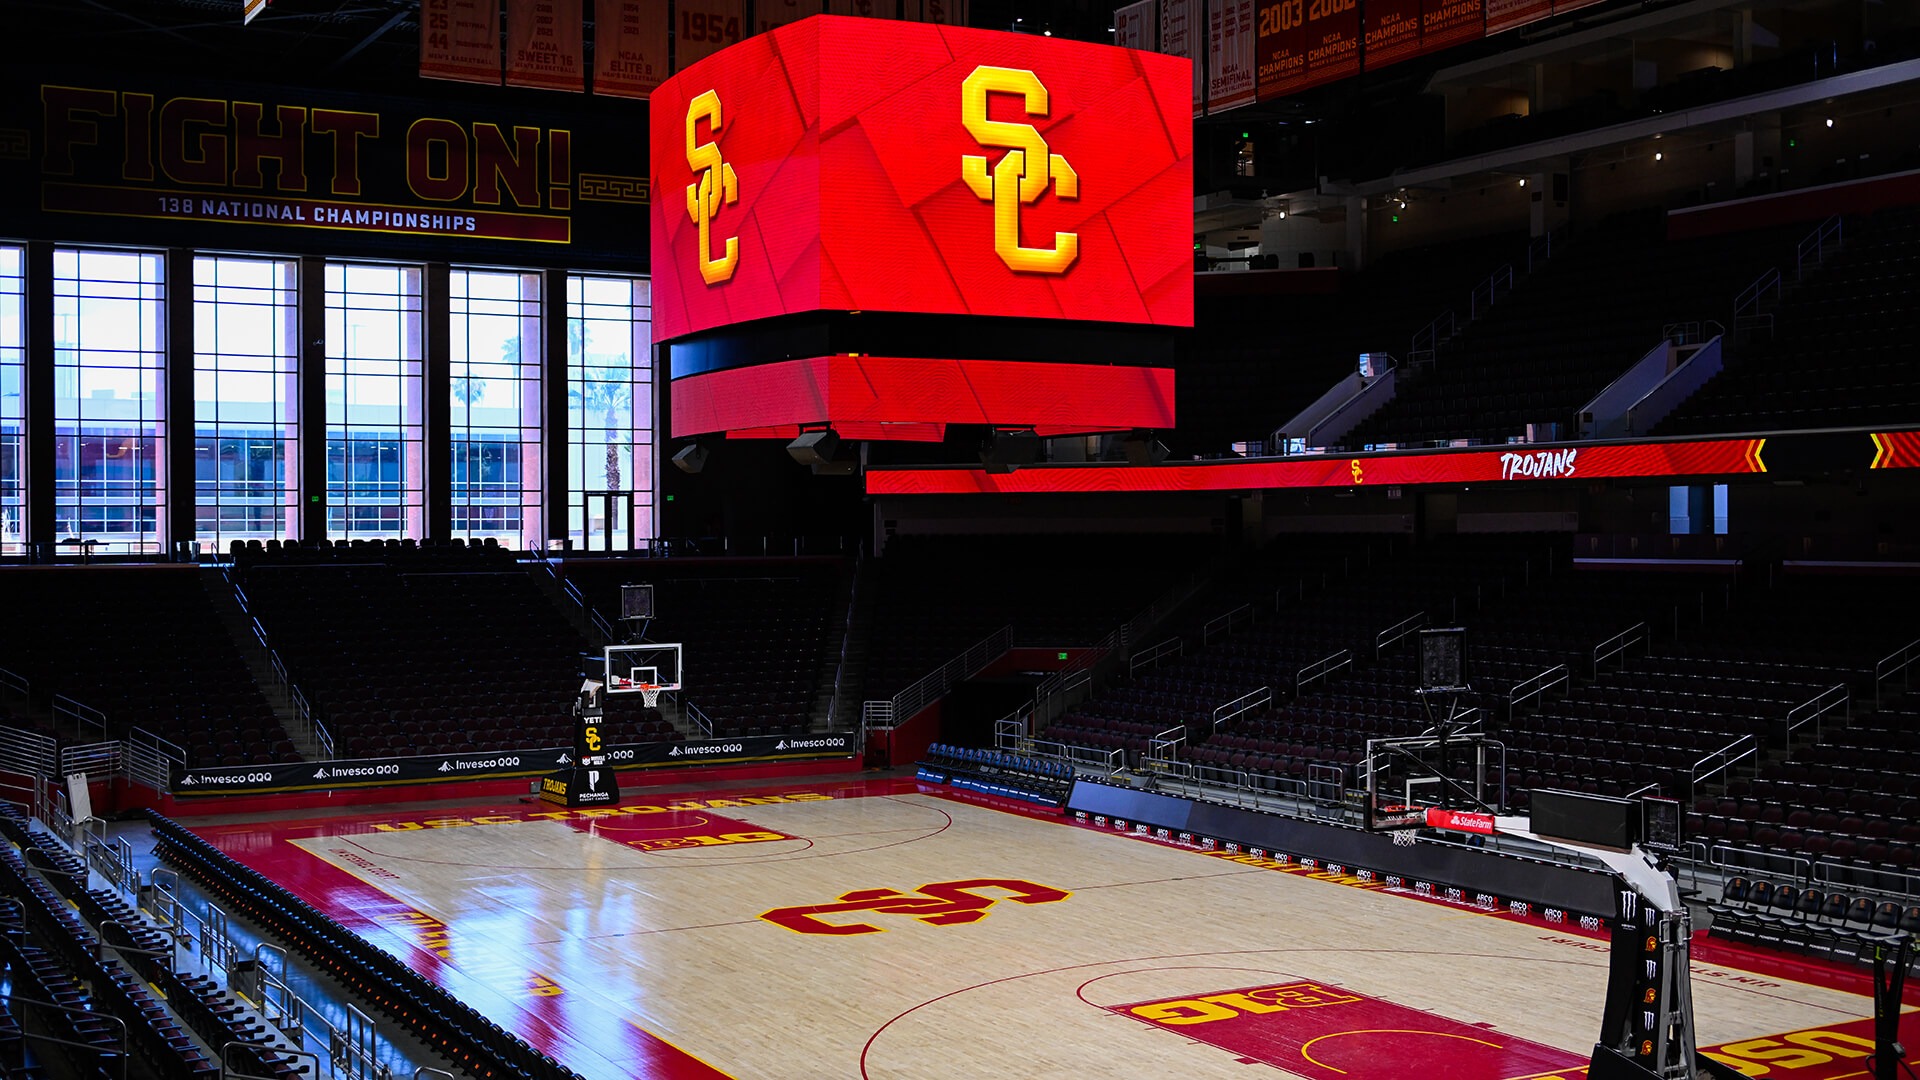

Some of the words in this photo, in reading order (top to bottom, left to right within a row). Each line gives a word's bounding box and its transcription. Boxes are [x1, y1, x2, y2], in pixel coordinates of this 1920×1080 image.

[1259, 0, 1303, 38] 2003
[1380, 12, 1400, 26] NCAA
[1424, 0, 1481, 26] CHAMPIONS
[1448, 12, 1480, 26] VOLLEYBALL
[430, 13, 448, 29] 25
[682, 11, 740, 43] 1954
[1119, 15, 1126, 30] 10
[537, 27, 553, 36] 2021
[1365, 17, 1418, 44] CHAMPIONS
[429, 32, 448, 49] 44
[1323, 32, 1341, 45] NCAA
[1388, 31, 1416, 44] VOLLEYBALL
[532, 41, 558, 52] NCAA
[1308, 37, 1357, 62] CHAMPIONS
[452, 56, 492, 64] BASKETBALL
[518, 50, 557, 64] SWEET
[560, 55, 573, 66] 16
[618, 51, 644, 62] NCAA
[1272, 48, 1290, 61] NCAA
[1330, 50, 1356, 62] VOLLEYBALL
[536, 64, 576, 73] BASKETBALL
[610, 60, 642, 74] ELITE
[646, 64, 652, 75] 8
[1222, 64, 1238, 74] NCAA
[1258, 54, 1304, 76] CHAMPIONS
[623, 73, 660, 82] BASKETBALL
[1279, 67, 1303, 78] VOLLEYBALL
[1212, 70, 1251, 89] SEMIFINAL
[1229, 81, 1252, 91] VOLLEYBALL
[41, 84, 379, 195] FIGHT
[407, 118, 570, 210] ON!
[962, 65, 1078, 274] SC
[686, 88, 738, 285] SC
[158, 196, 193, 215] 138
[202, 198, 306, 222] NATIONAL
[314, 206, 476, 231] CHAMPIONSHIPS
[1501, 447, 1576, 481] TROJANS
[1350, 459, 1363, 484] SC
[586, 727, 601, 751] SC
[791, 738, 824, 749] Invesco
[826, 737, 845, 747] QQQ
[613, 750, 634, 759] QQQ
[685, 744, 721, 755] Invesco
[723, 743, 742, 753] QQQ
[456, 760, 496, 770] Invesco
[498, 757, 520, 768] QQQ
[332, 767, 375, 777] Invesco
[376, 764, 399, 775] QQQ
[200, 774, 246, 783] Invesco
[248, 772, 272, 783] QQQ
[543, 778, 567, 795] TROJANS
[528, 793, 834, 820] TROJANS
[1250, 848, 1262, 856] ARCO
[1274, 853, 1288, 861] ARCO
[1301, 858, 1314, 866] ARCO
[1327, 864, 1341, 872] ARCO
[1357, 870, 1371, 878] ARCO
[1386, 876, 1400, 885] ARCO
[1416, 882, 1430, 890] ARCO
[1477, 893, 1493, 902] ARCO
[1510, 901, 1527, 910] ARCO
[1544, 908, 1562, 918] ARCO
[1580, 916, 1598, 926] ARCO
